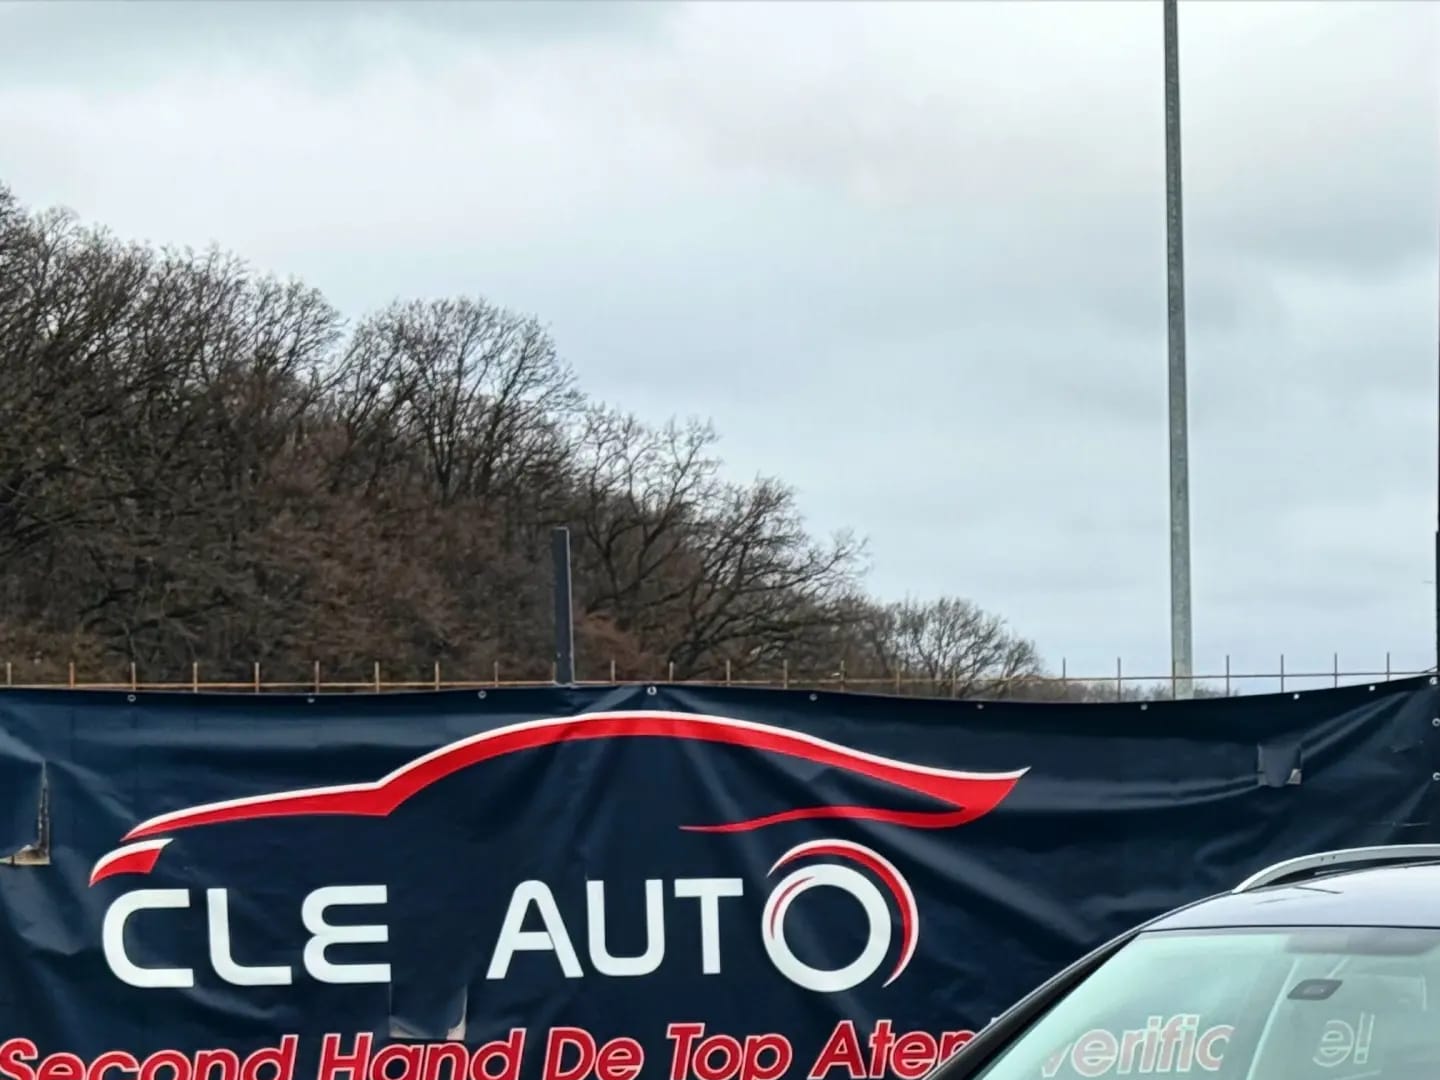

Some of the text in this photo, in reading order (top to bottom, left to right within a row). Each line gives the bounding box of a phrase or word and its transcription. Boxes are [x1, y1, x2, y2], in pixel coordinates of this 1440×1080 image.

[103, 863, 892, 993] CLE AUTO
[805, 1017, 1001, 1080] Aten
